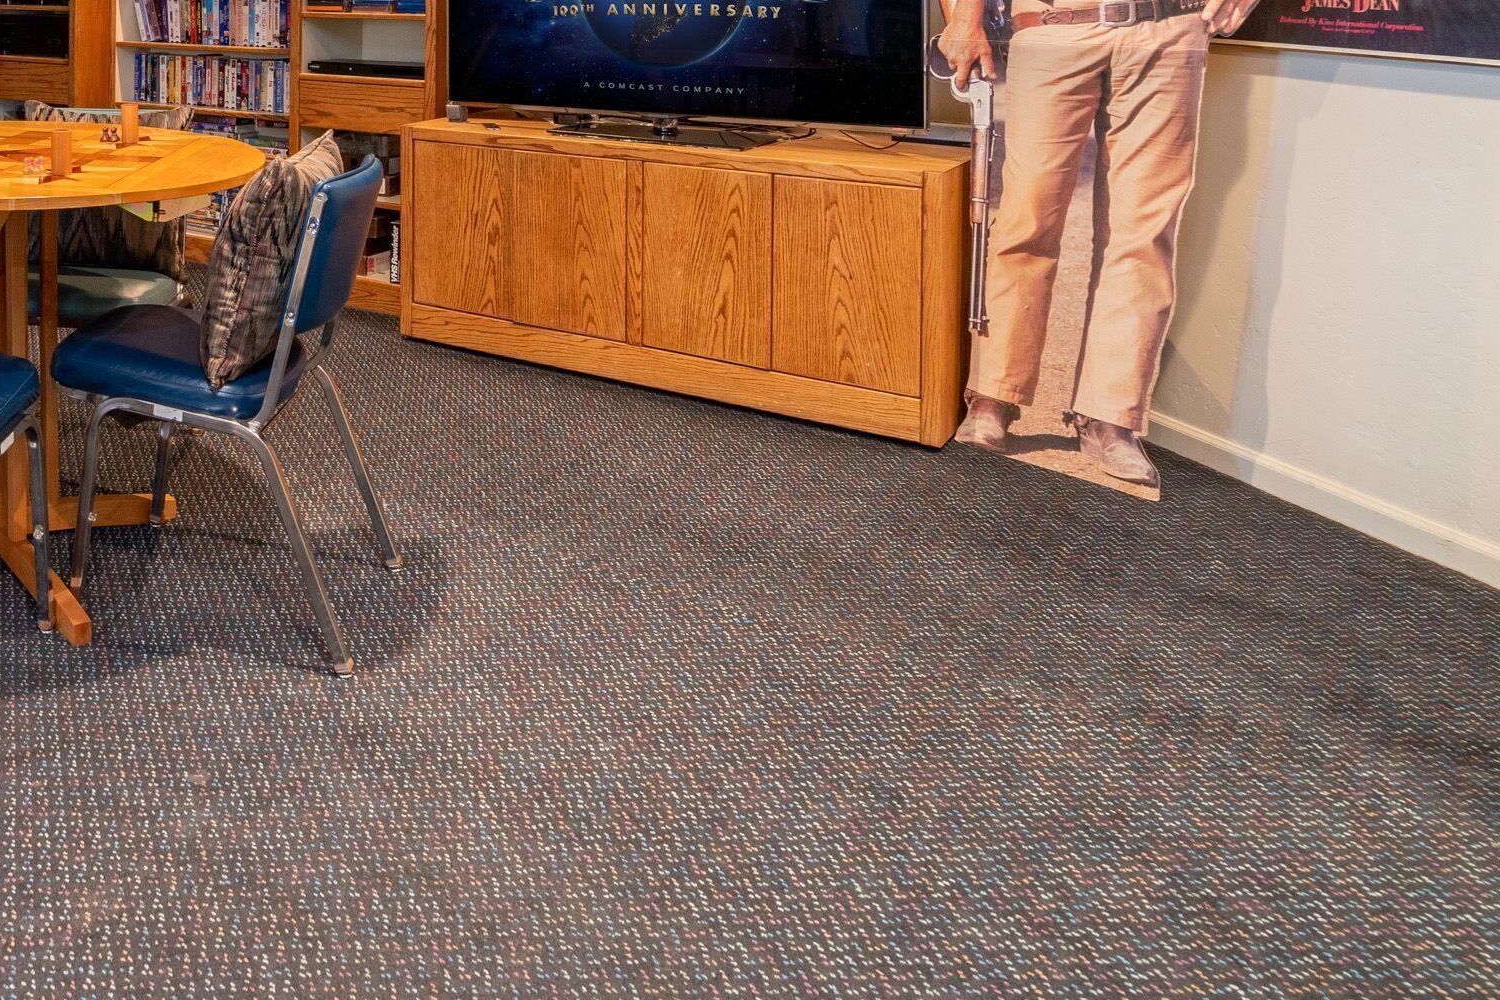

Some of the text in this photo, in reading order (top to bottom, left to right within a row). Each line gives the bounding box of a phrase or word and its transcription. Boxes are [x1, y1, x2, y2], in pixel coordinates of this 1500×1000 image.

[607, 3, 782, 19] ANNIVERSARY
[599, 81, 664, 92] COMCAST
[672, 84, 746, 95] COMPANY
